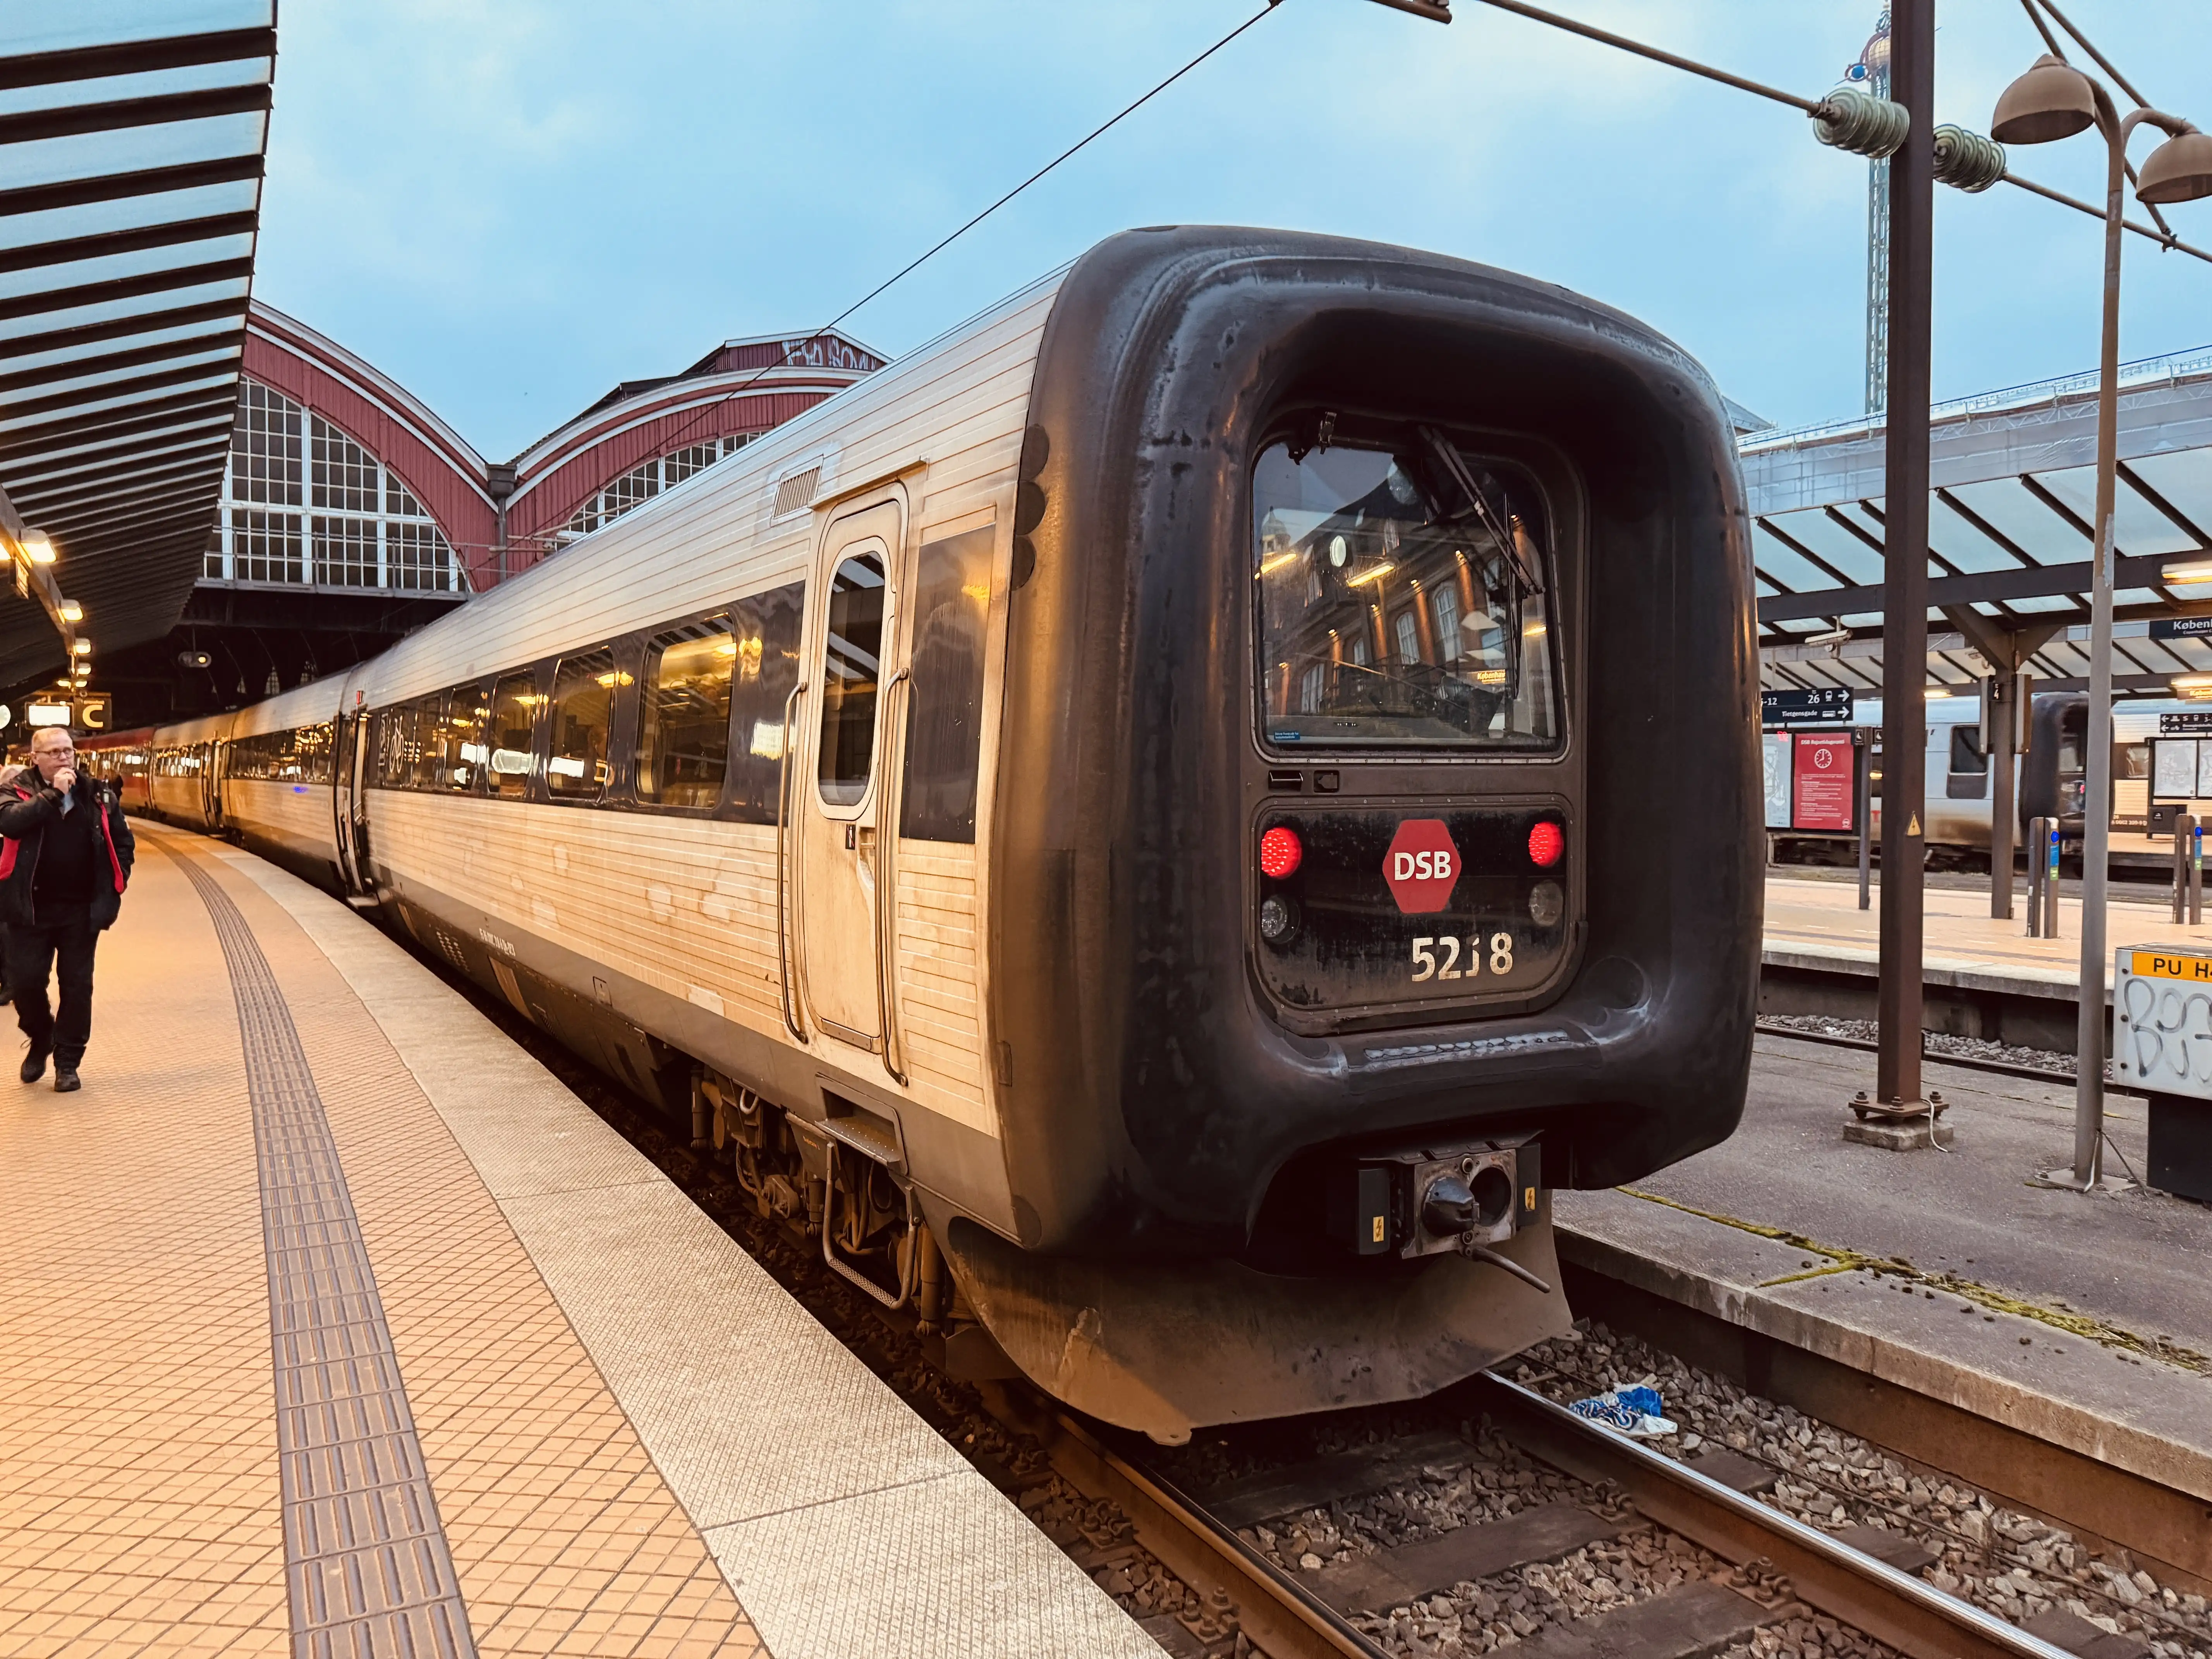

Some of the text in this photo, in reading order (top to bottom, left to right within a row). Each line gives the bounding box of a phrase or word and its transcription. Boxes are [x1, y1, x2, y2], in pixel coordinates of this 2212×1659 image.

[1808, 694, 1820, 704] 26
[1994, 689, 1999, 699] 4
[82, 705, 103, 727] C
[1395, 851, 1451, 880] DSB
[1412, 933, 1513, 981] 5218
[2154, 958, 2212, 978] PU H
